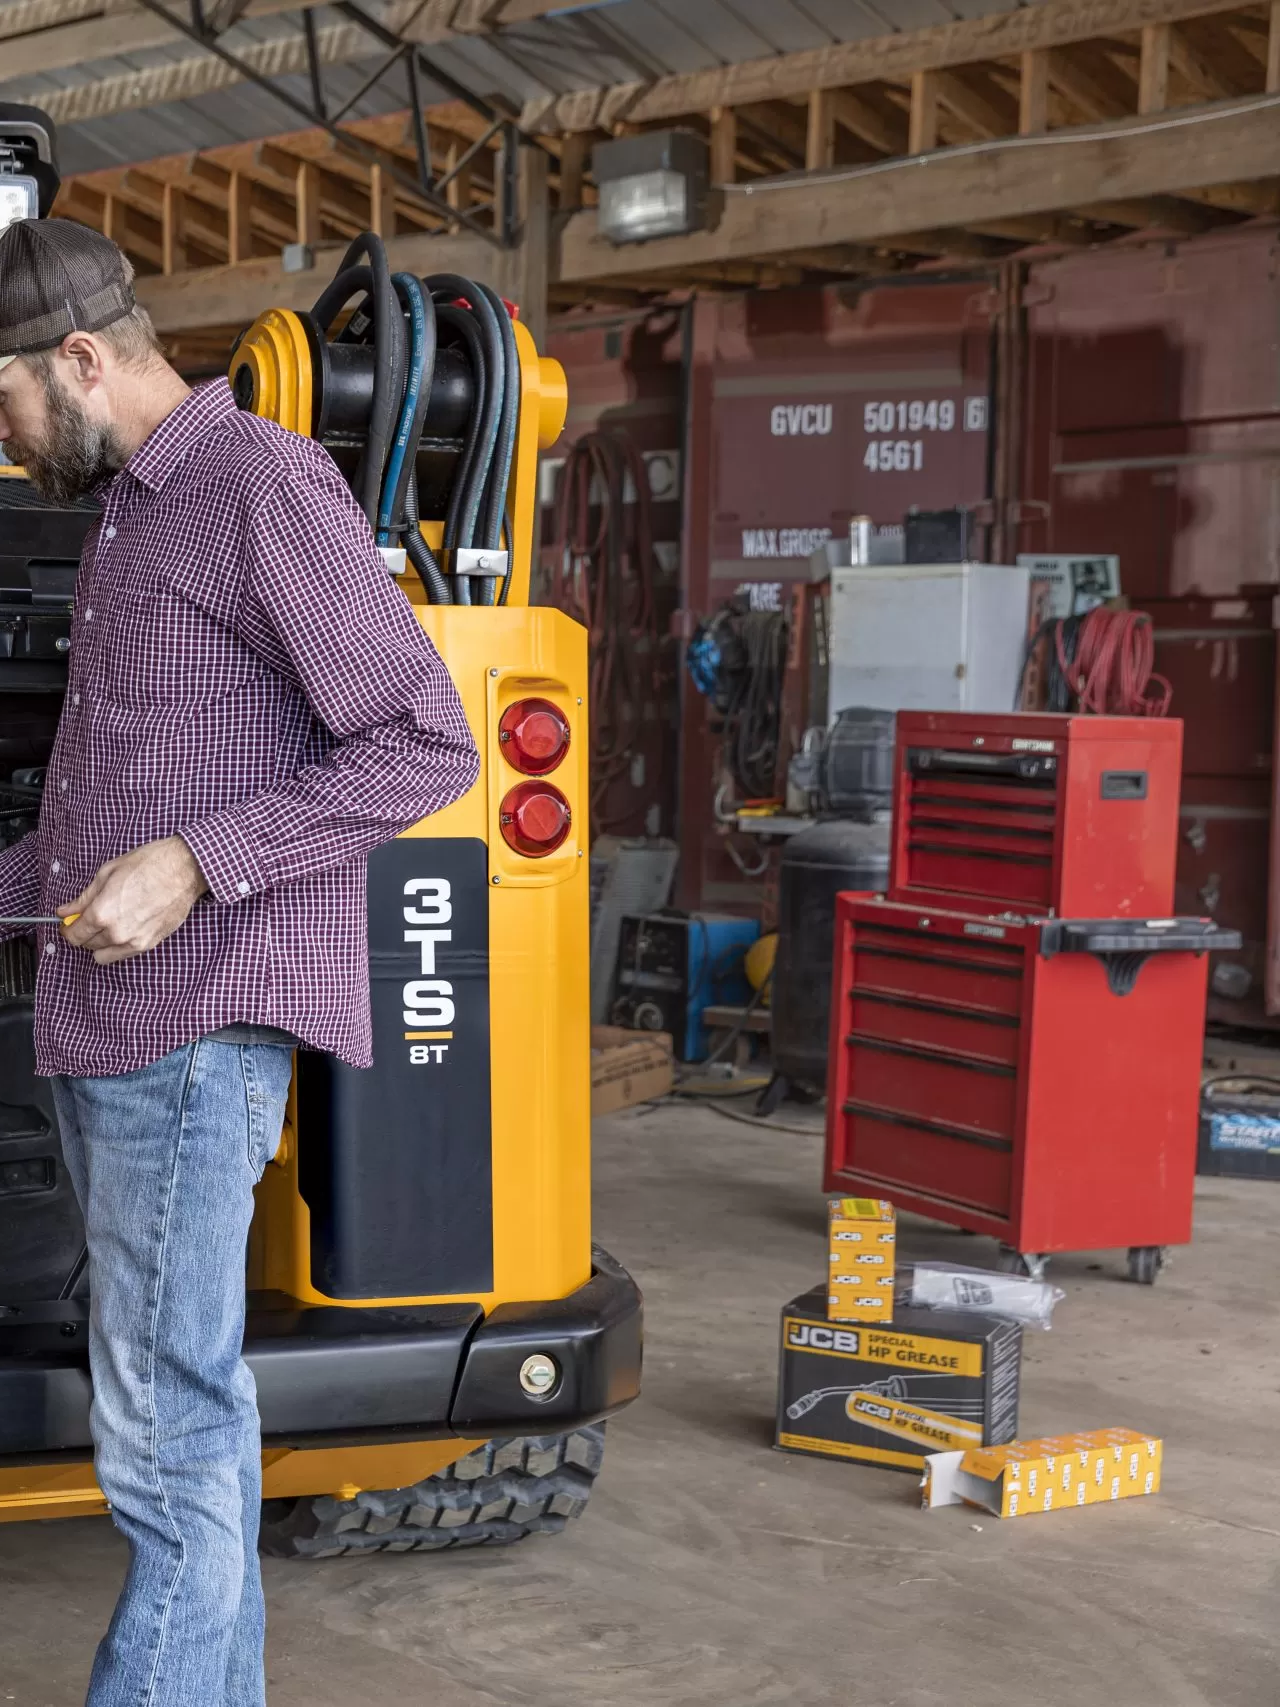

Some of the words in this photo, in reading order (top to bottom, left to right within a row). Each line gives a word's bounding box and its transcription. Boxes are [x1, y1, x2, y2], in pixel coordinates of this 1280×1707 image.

[771, 404, 832, 435] GVCU
[864, 400, 955, 433] 501949
[410, 1045, 448, 1064] 8T
[833, 1232, 862, 1241] JCB
[878, 1234, 895, 1242] JC
[855, 1255, 884, 1264] JCB
[832, 1275, 861, 1284] JCB
[876, 1277, 894, 1285] JC
[854, 1298, 882, 1306] JCB
[789, 1326, 858, 1352] JCB
[868, 1334, 915, 1348] SPECIAL
[868, 1346, 891, 1358] HP
[896, 1350, 959, 1368] GREASE
[855, 1400, 891, 1418] JCB
[911, 1421, 951, 1443] GREASE
